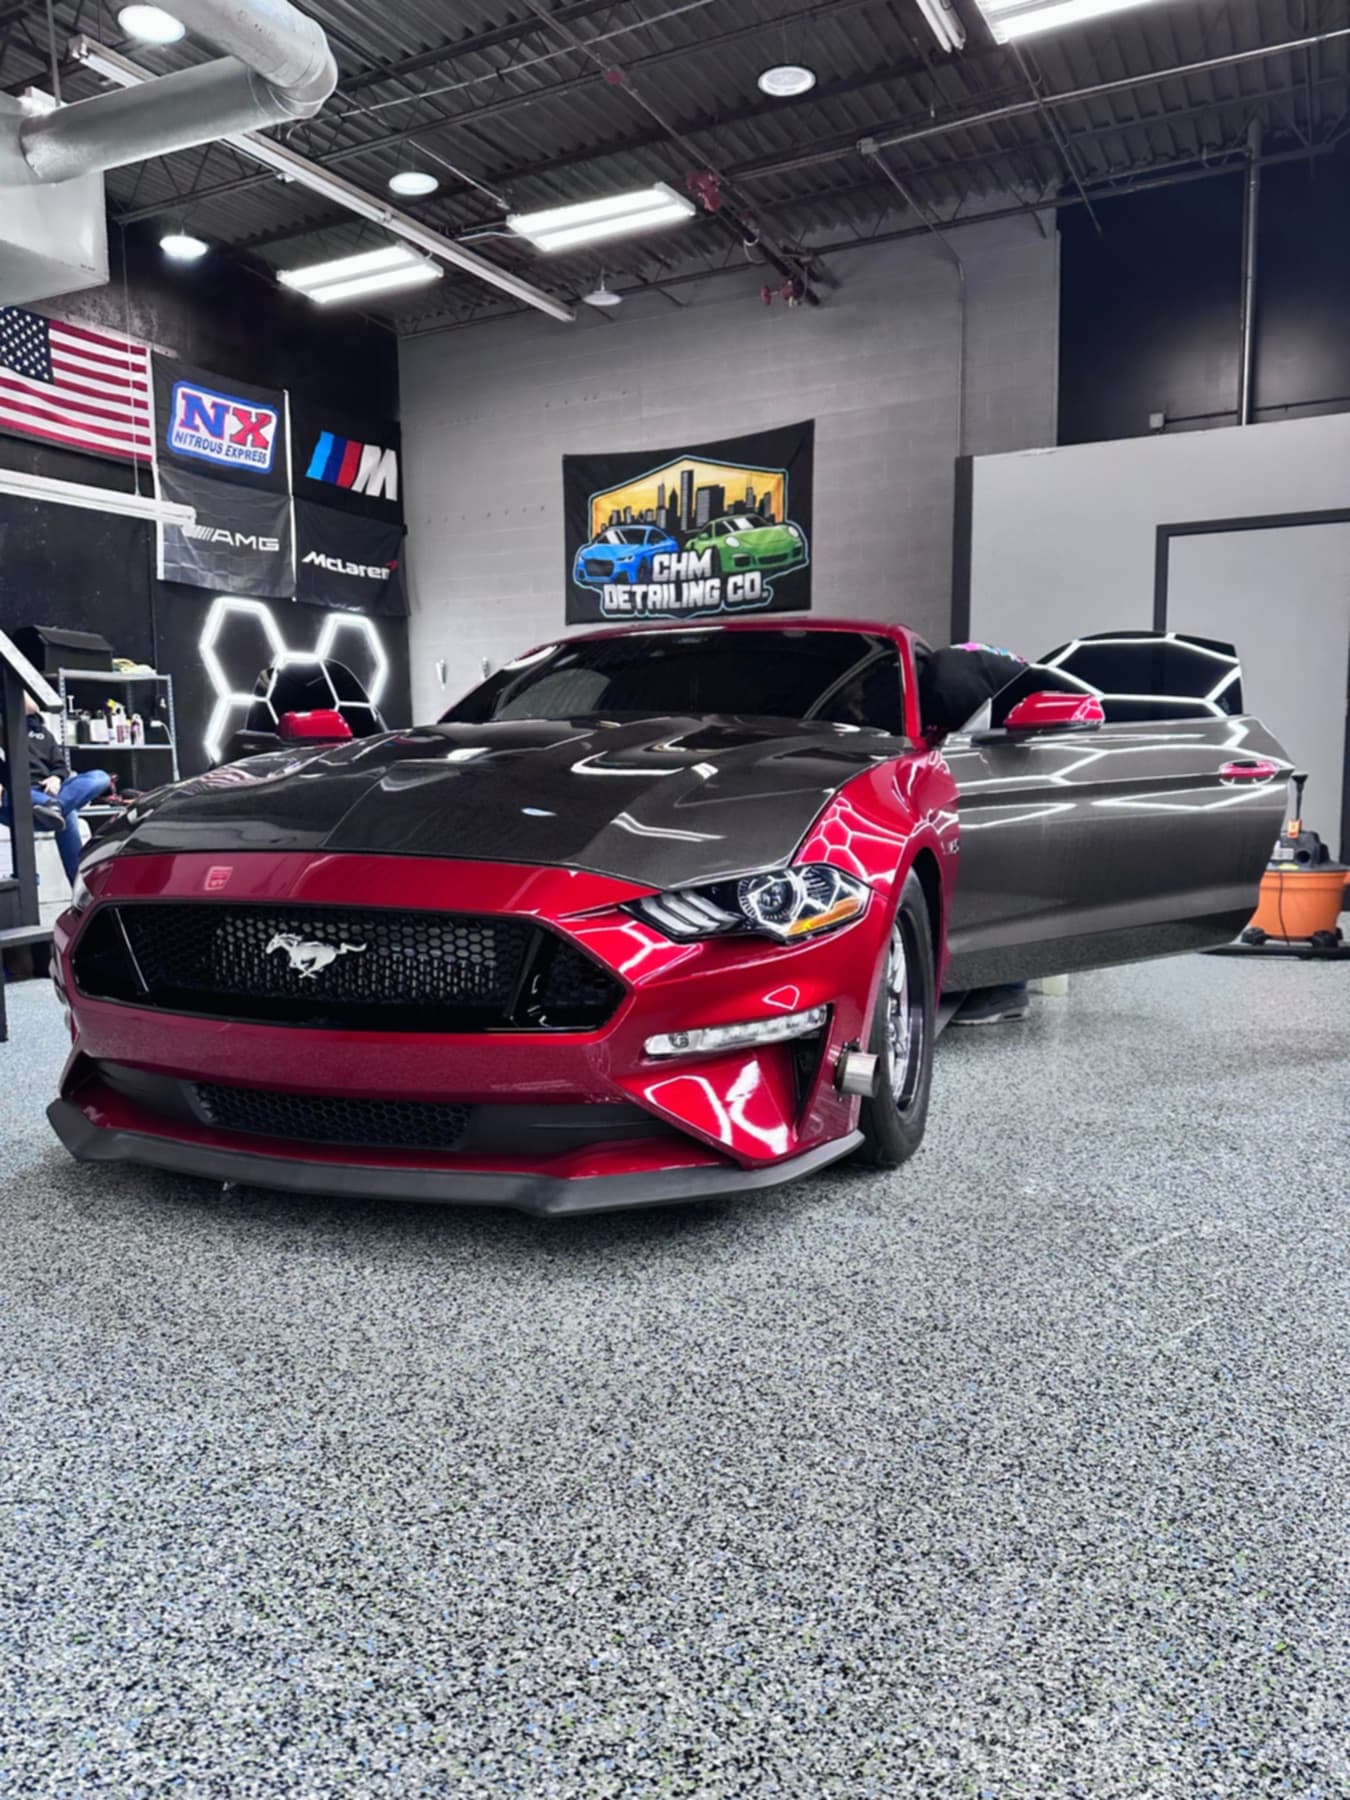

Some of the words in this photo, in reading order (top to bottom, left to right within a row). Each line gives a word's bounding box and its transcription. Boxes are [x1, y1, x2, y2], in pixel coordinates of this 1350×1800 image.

[178, 389, 273, 451] NX
[174, 431, 223, 455] NITROUS
[225, 445, 268, 465] EXPRESS
[211, 528, 280, 553] AMG
[652, 548, 713, 582] CHM
[603, 577, 721, 611] DETAILING
[726, 570, 769, 603] CO.
